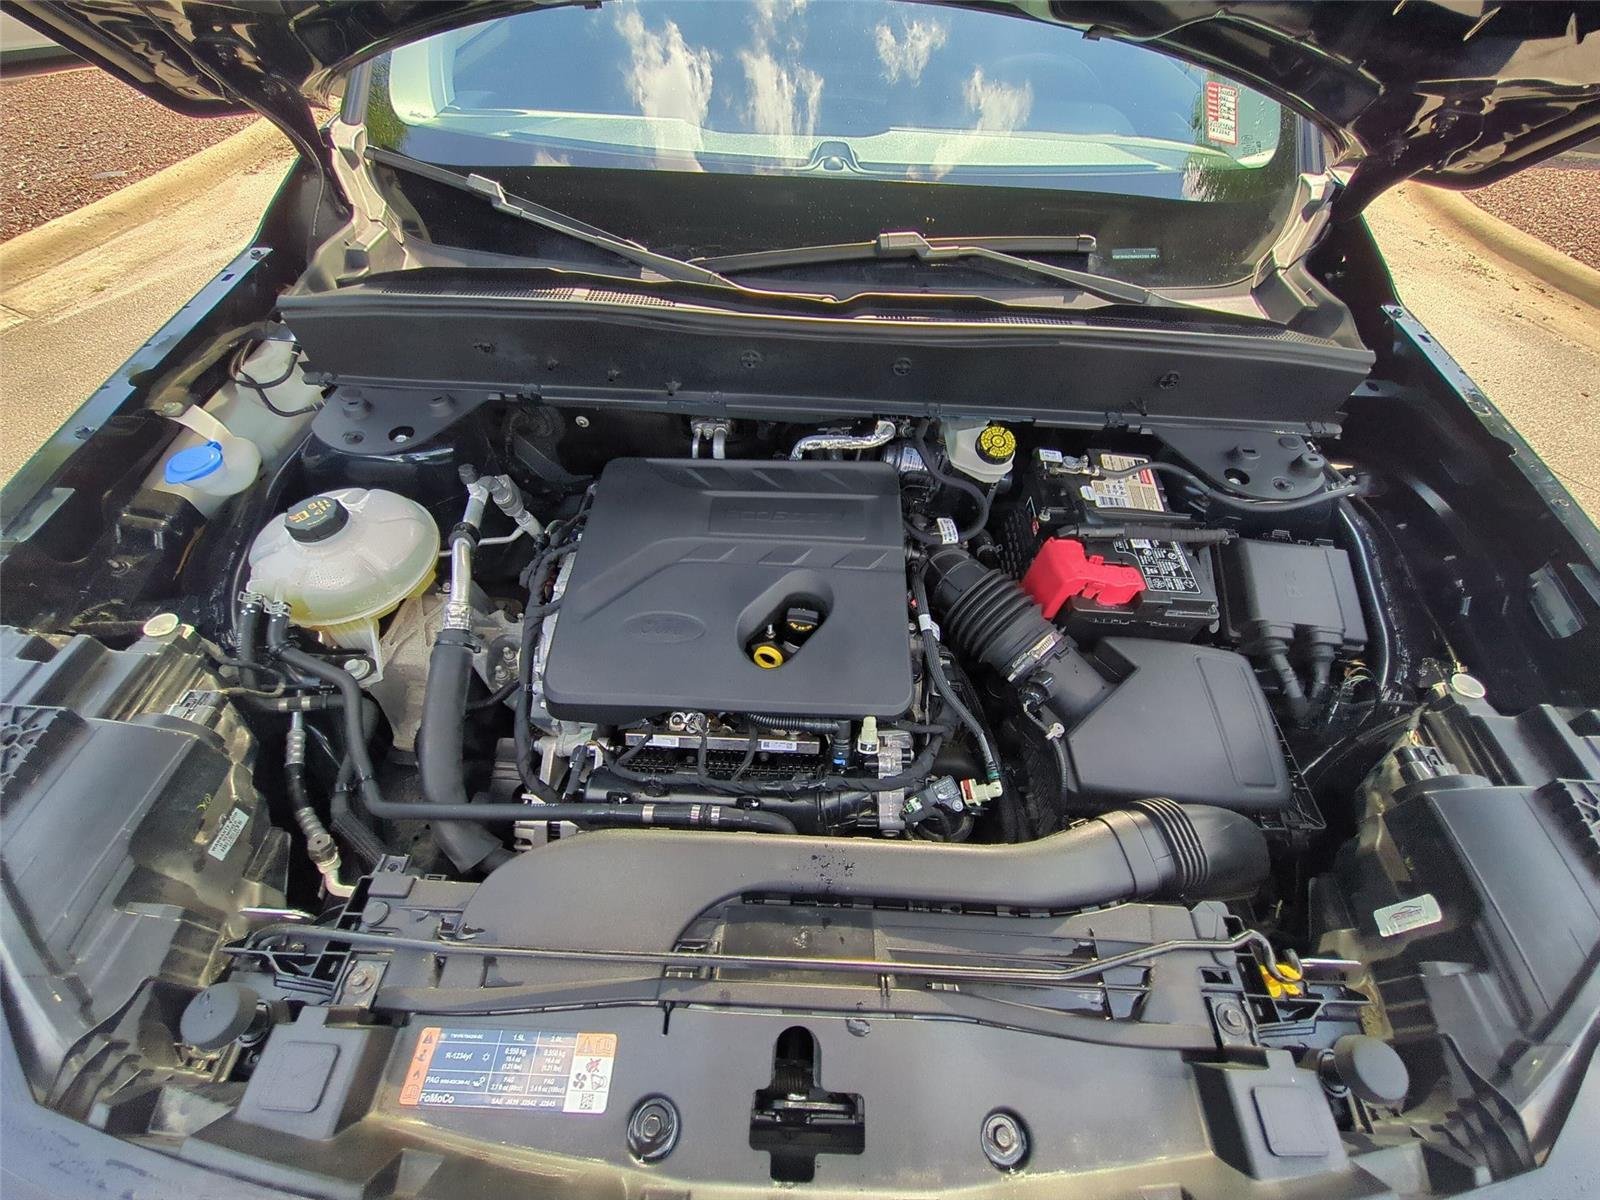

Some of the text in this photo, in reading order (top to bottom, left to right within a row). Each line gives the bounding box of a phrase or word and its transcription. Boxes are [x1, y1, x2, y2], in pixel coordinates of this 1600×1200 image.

[445, 1051, 473, 1062] R-1234yf
[425, 1076, 440, 1084] PAG
[419, 1092, 455, 1104] FoMoCo
